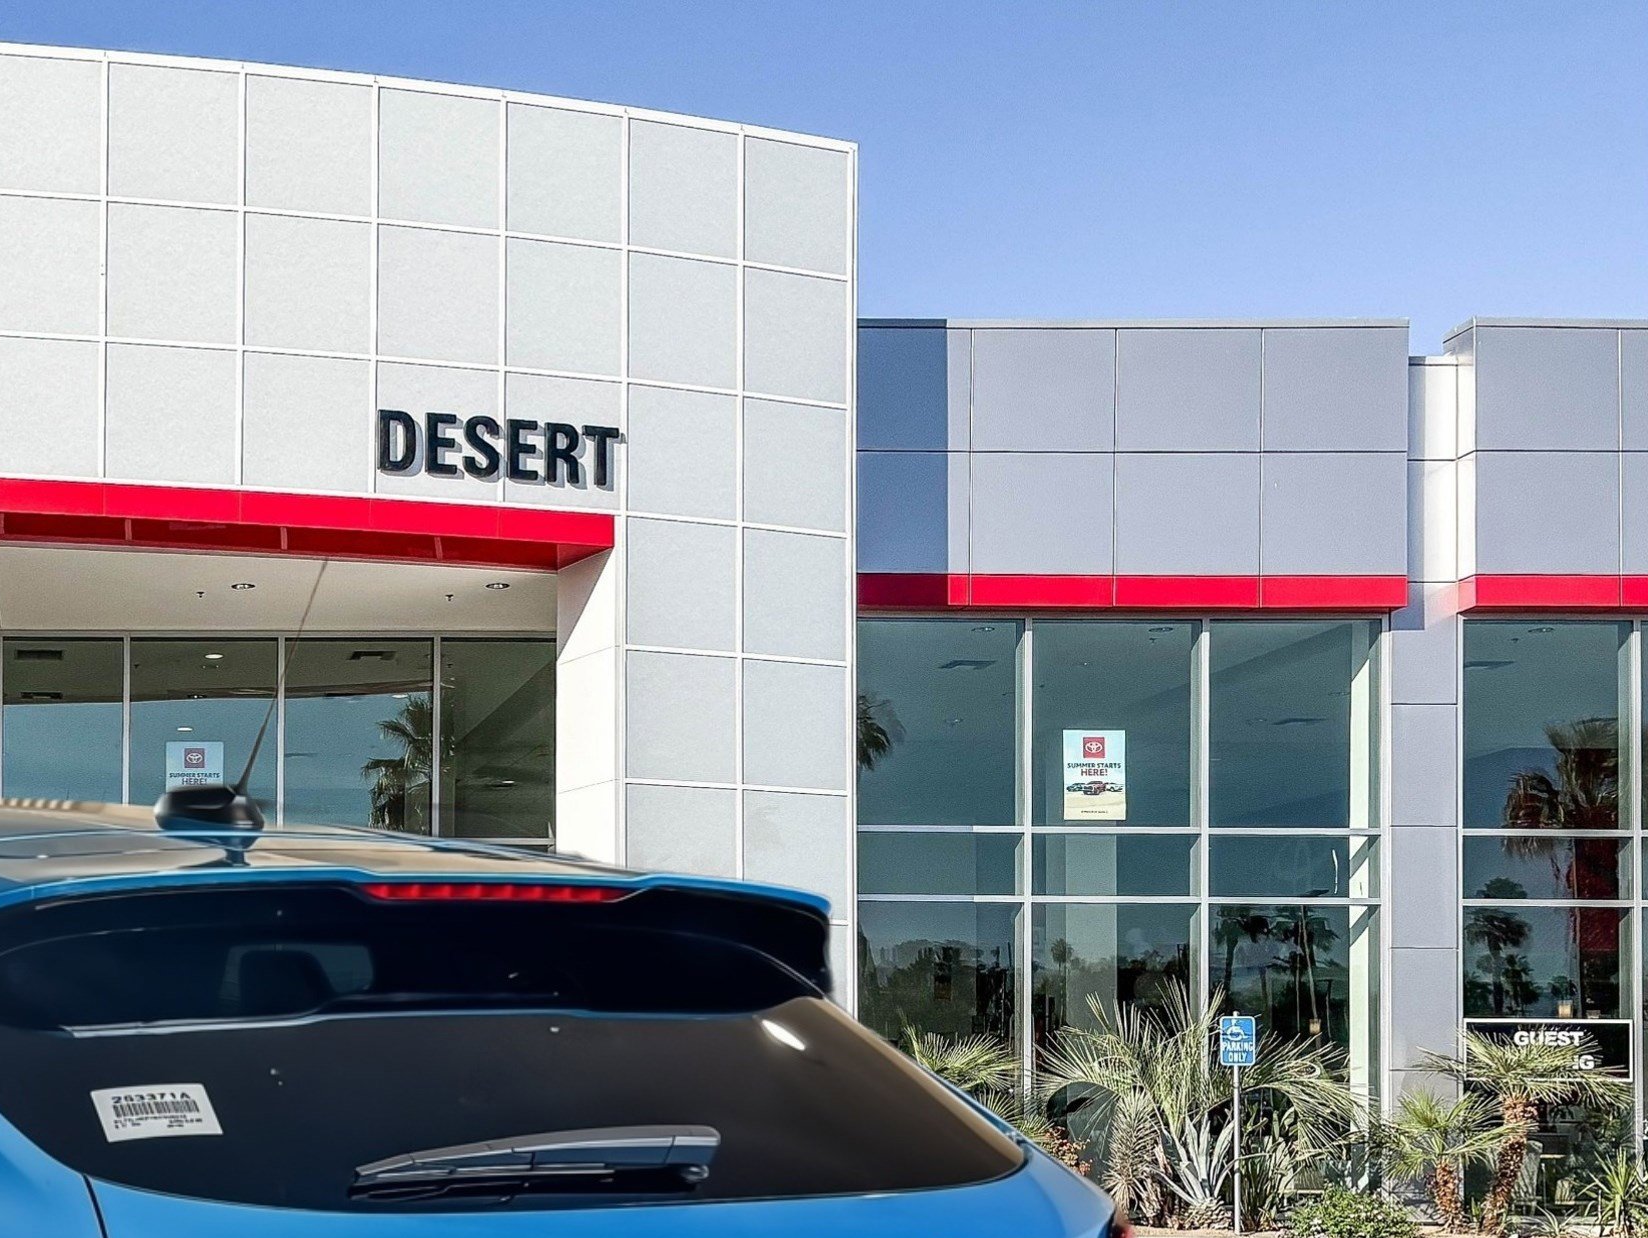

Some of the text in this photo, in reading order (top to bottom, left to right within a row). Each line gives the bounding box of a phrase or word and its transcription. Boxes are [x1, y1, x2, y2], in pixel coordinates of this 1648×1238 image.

[377, 409, 620, 486] DESERT
[1080, 768, 1108, 777] HERE!
[181, 778, 208, 786] HERE!
[1513, 1031, 1584, 1047] GUEST
[1222, 1041, 1253, 1052] PARKING
[1228, 1052, 1248, 1063] ONLY
